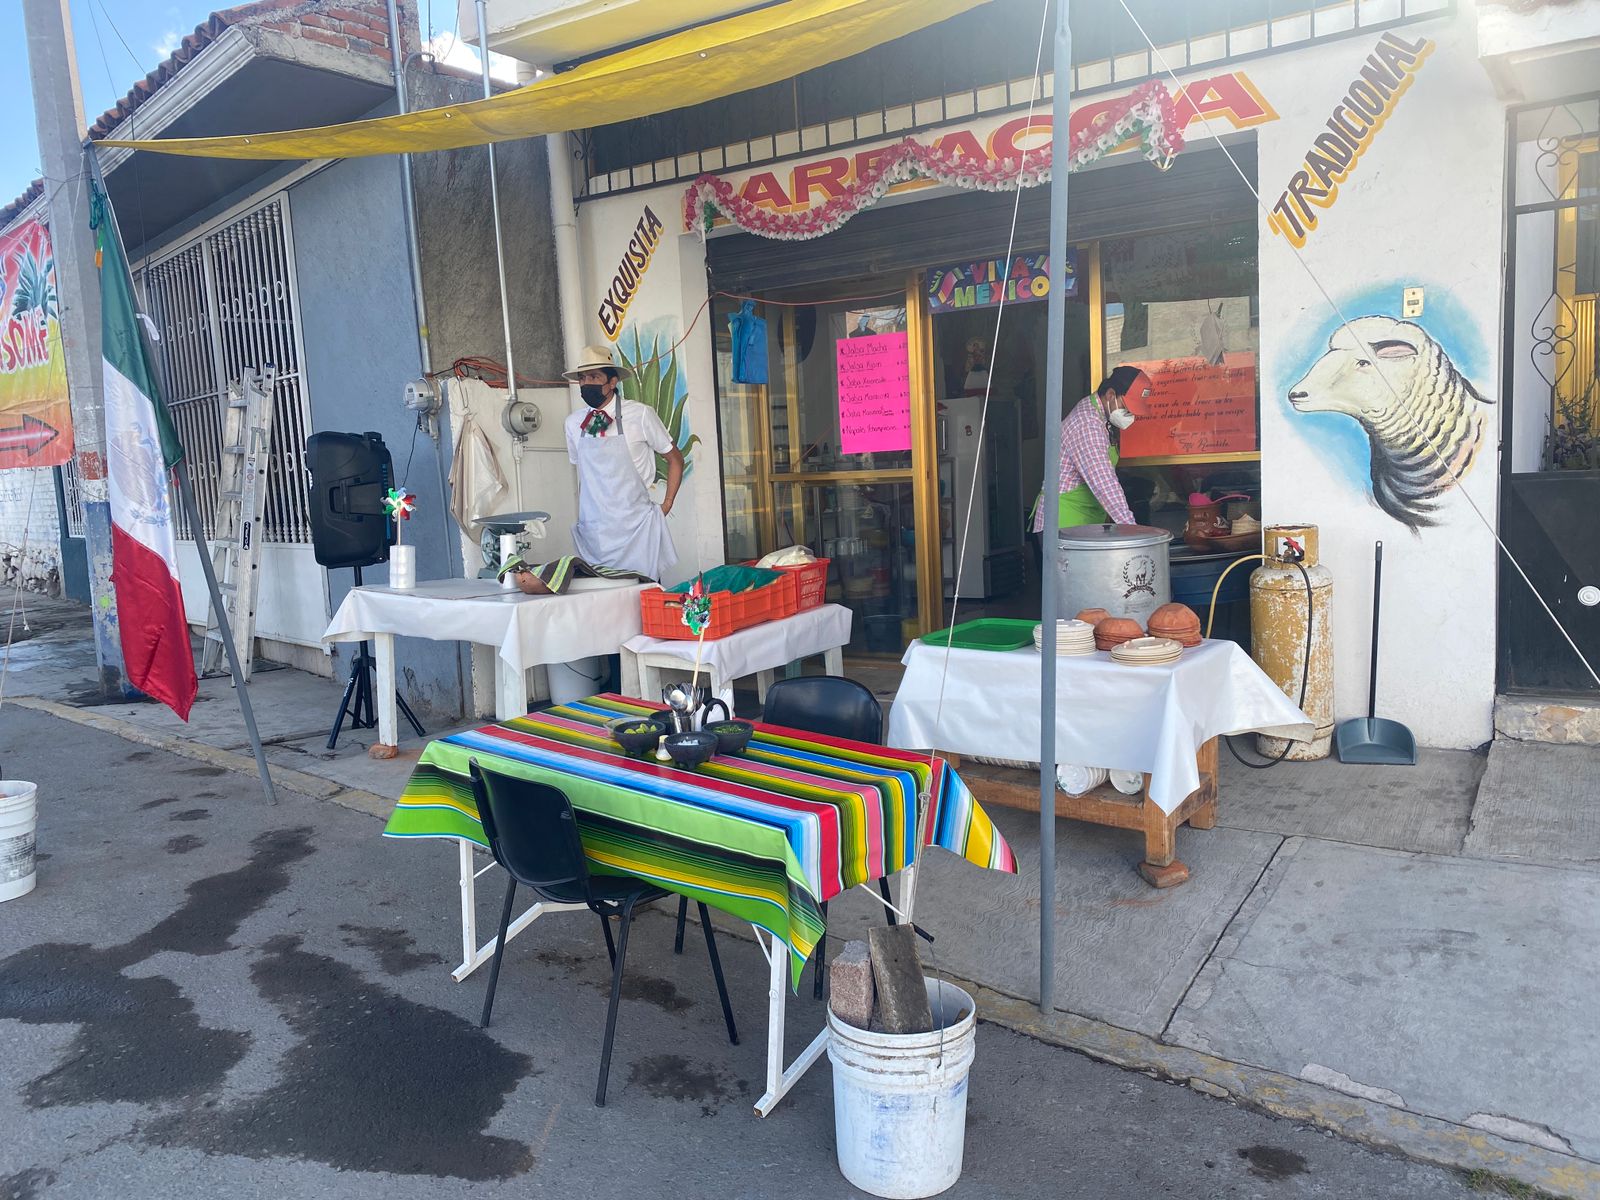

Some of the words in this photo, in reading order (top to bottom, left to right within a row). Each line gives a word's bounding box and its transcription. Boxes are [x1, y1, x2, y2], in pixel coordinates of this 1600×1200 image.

[1268, 31, 1435, 248] TRADICIONAL
[598, 205, 664, 341] EXQUISITA
[971, 256, 1030, 284] VIVA
